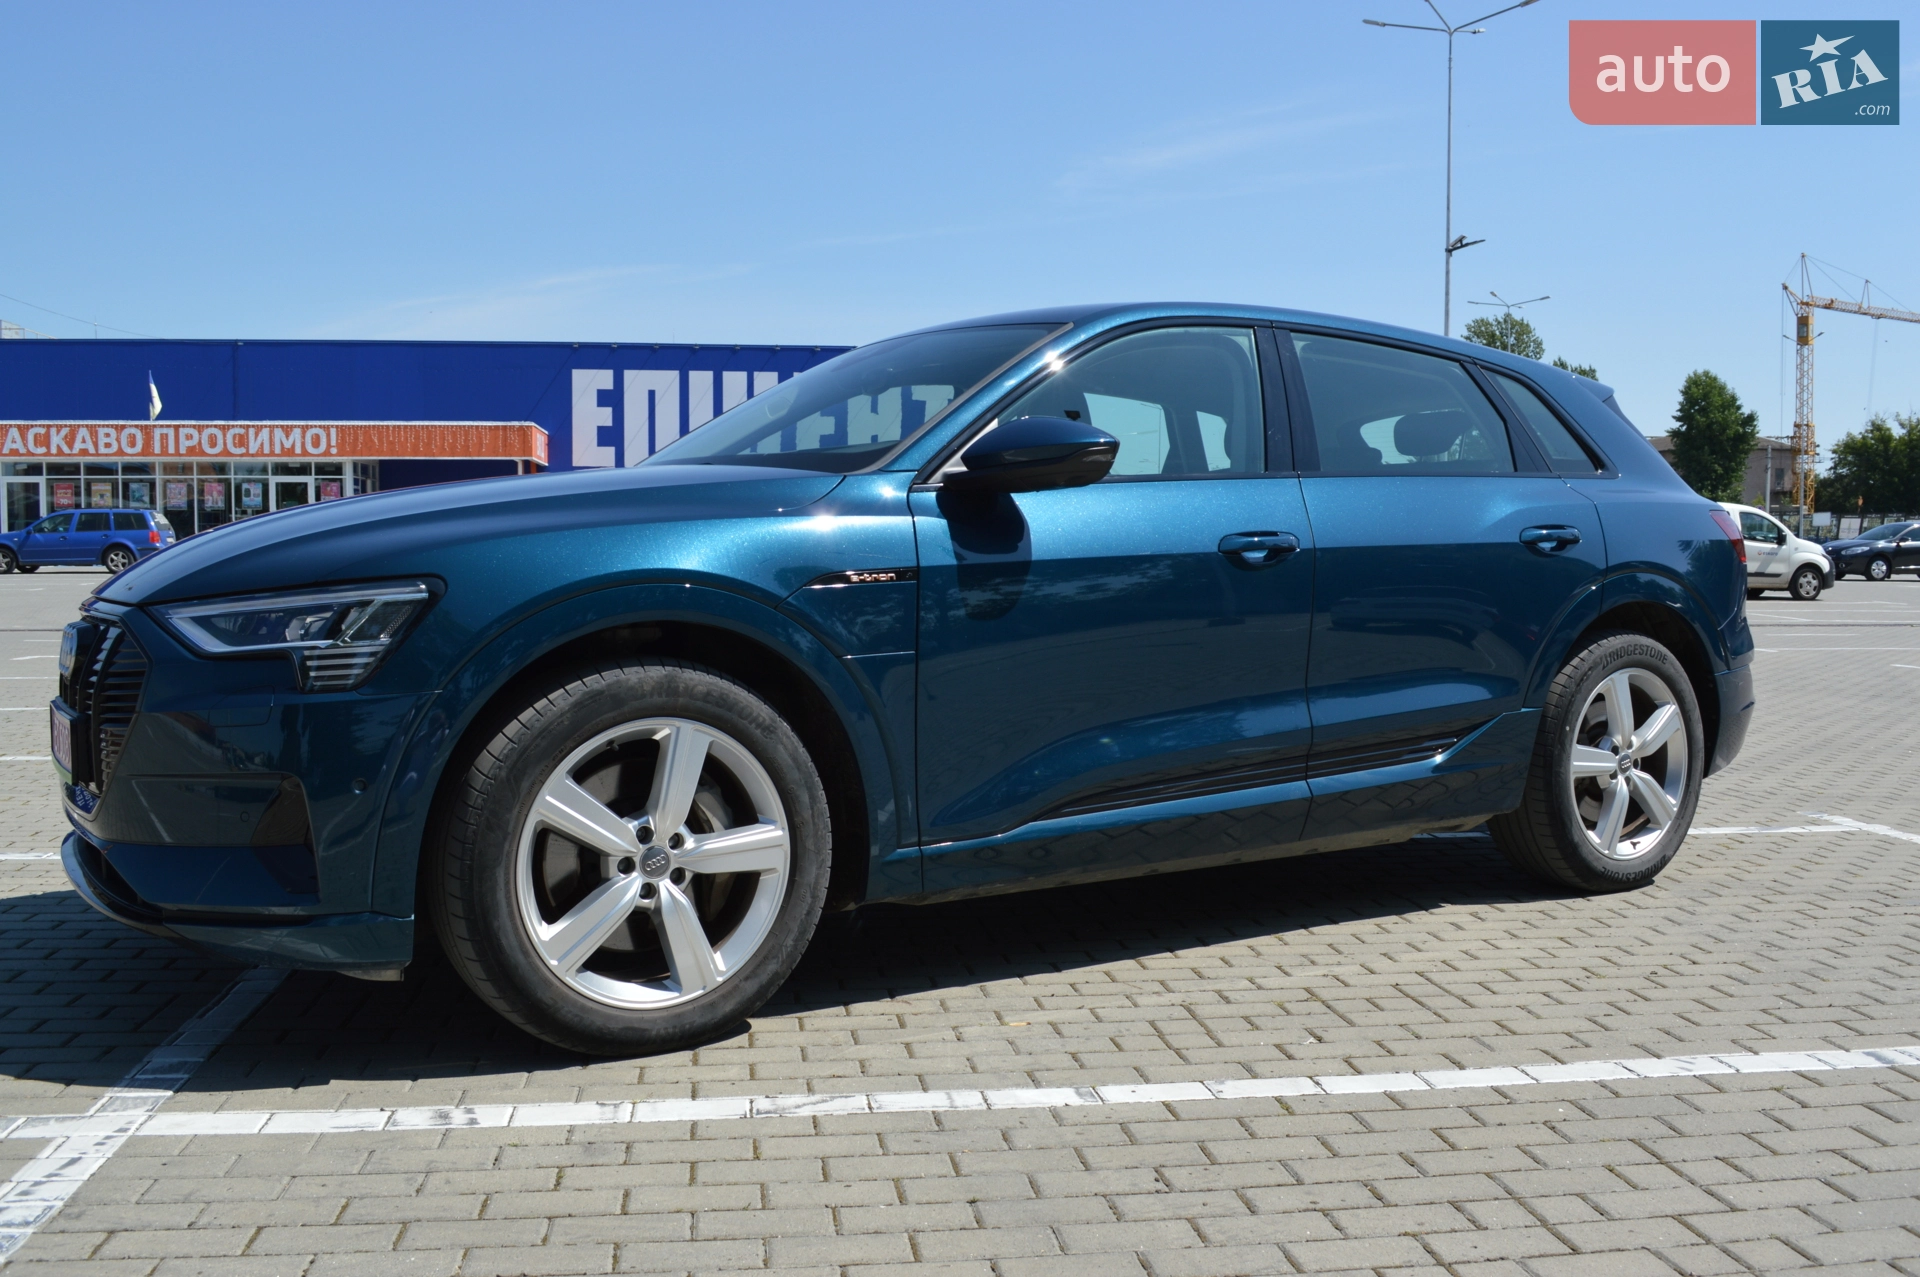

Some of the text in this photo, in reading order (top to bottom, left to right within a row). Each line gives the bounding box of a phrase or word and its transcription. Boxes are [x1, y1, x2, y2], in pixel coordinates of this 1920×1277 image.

[2, 426, 338, 455] АСКАВО ПРОСИМО!
[850, 573, 897, 583] e-tron
[1600, 643, 1669, 671] BRIDGESTONE
